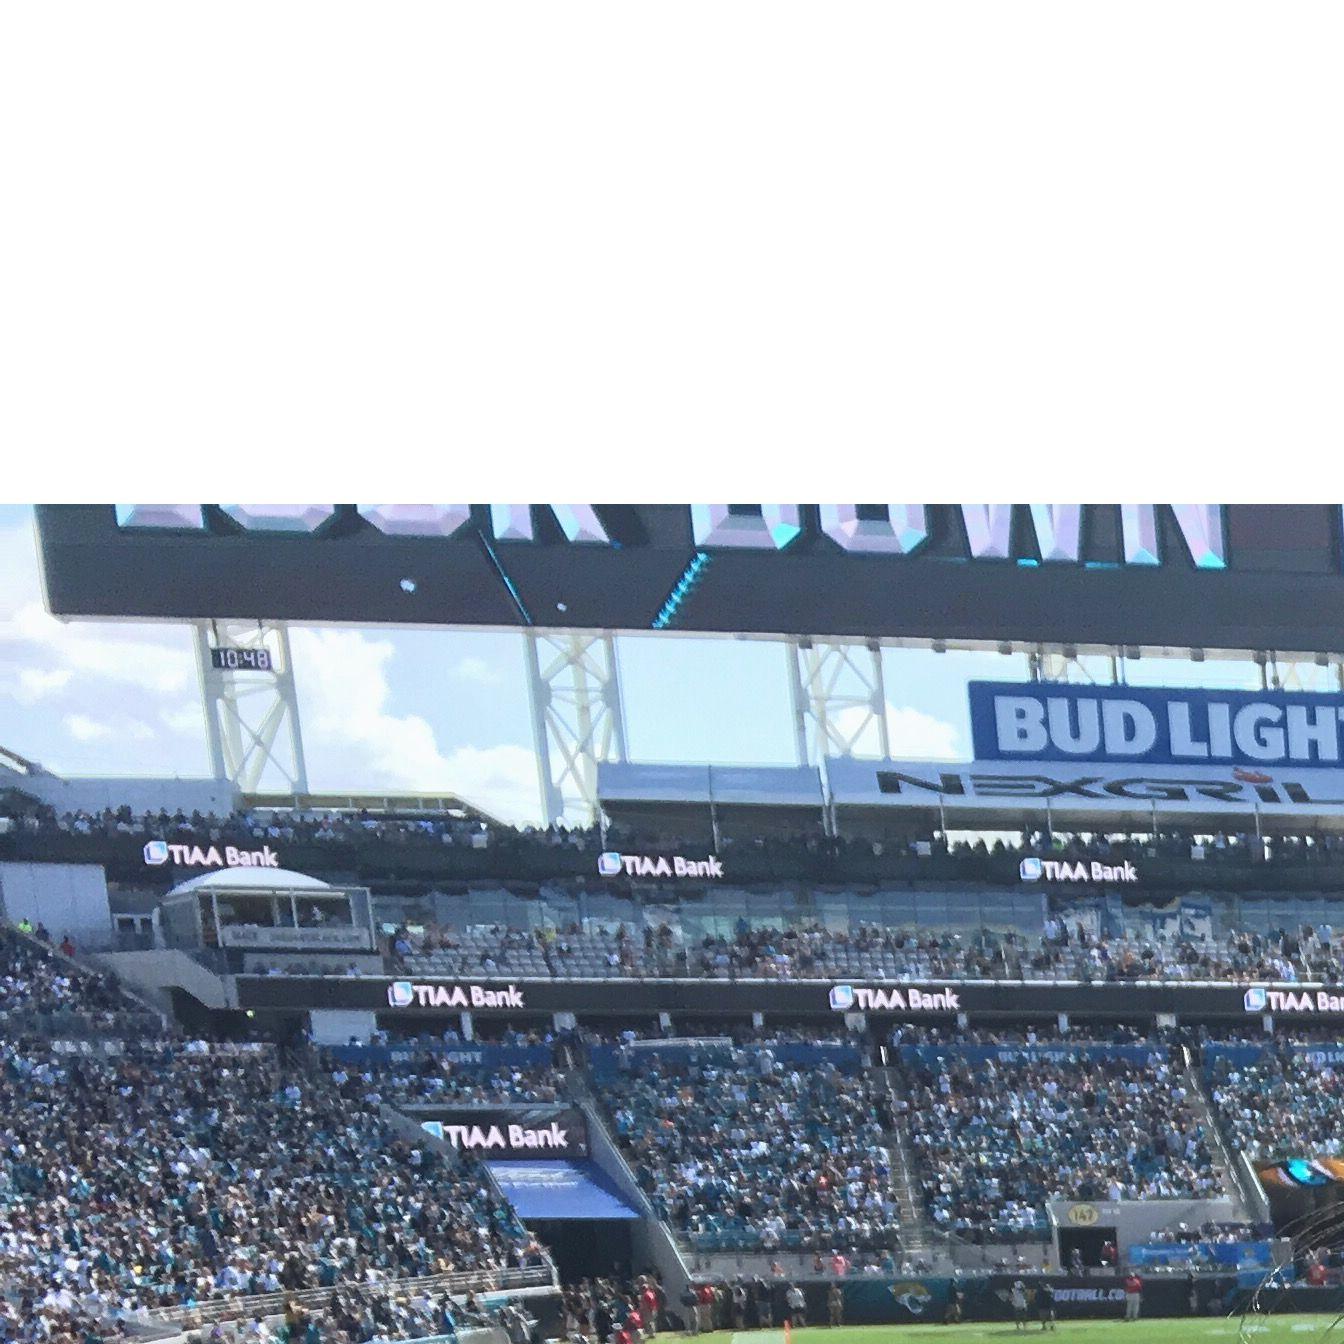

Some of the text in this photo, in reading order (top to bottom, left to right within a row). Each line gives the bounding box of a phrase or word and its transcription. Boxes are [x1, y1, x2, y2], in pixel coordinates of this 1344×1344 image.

[994, 695, 1157, 755] BUD
[168, 844, 279, 867] TIAA Bank
[621, 855, 724, 879] TIAA Bank
[1041, 859, 1138, 883] TIAA Bank
[412, 984, 525, 1009] TIAA Bank
[853, 987, 961, 1012] TIAA Bank
[1265, 991, 1315, 1012] TIAA
[443, 1122, 570, 1149] TIAA Bank
